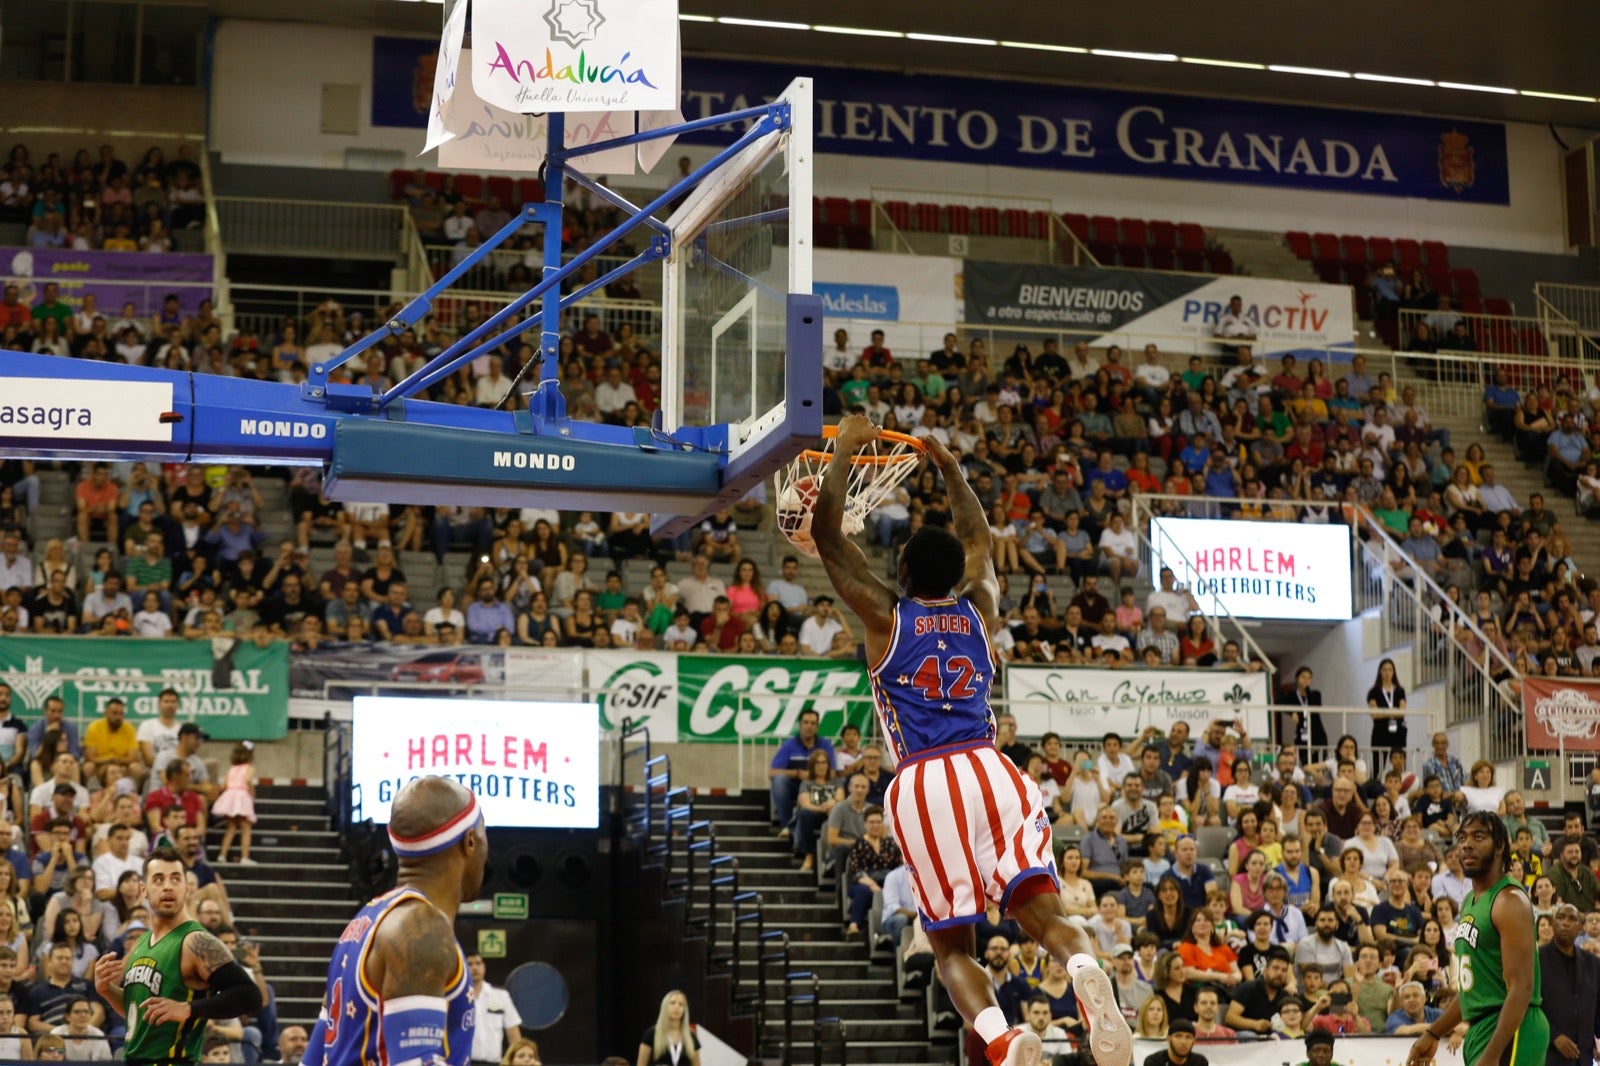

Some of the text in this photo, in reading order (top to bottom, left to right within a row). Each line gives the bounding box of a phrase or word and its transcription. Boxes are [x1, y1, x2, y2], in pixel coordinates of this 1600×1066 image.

[487, 41, 658, 90] Andalucía
[515, 85, 629, 105] Huella Universal
[1017, 115, 1096, 158] DE
[822, 292, 888, 314] Adeslas
[1019, 284, 1144, 312] BIENVENIDOS
[987, 306, 996, 318] a
[998, 307, 1022, 319] otro
[1096, 312, 1112, 324] de
[1183, 300, 1328, 332] PRACTIV
[0, 406, 92, 430] asagra
[240, 419, 326, 439] MONDO
[493, 451, 576, 471] MONDO
[1196, 547, 1296, 577] HARLEM
[73, 667, 150, 693] CAJA
[160, 668, 269, 694] RUAL
[911, 655, 977, 701] 42
[134, 697, 249, 715] GNADA
[610, 683, 672, 709] CSIF
[690, 664, 861, 735] CSIF
[408, 733, 547, 774] HARLEM
[1531, 769, 1546, 789] A
